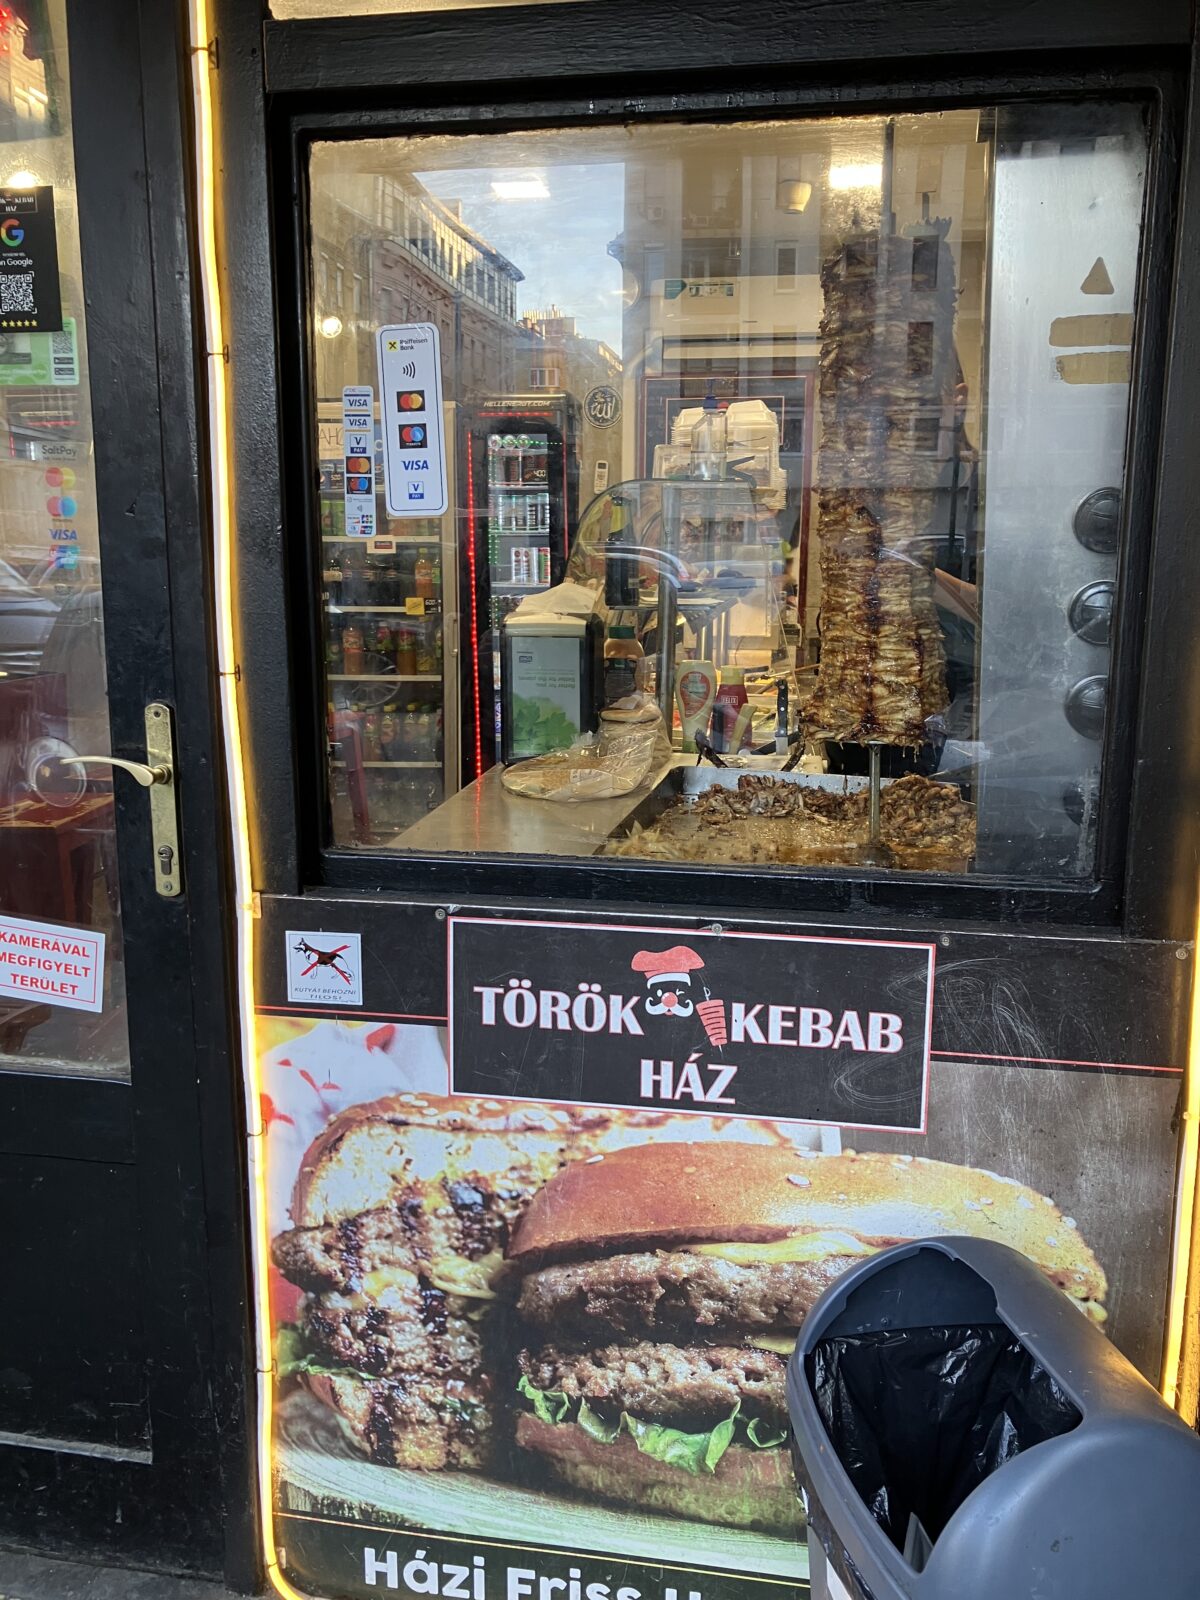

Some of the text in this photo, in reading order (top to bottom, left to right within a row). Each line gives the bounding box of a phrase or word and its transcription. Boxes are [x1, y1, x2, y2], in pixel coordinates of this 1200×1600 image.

[7, 257, 33, 267] Google
[348, 399, 368, 407] VISA
[349, 418, 368, 427] VISA
[354, 436, 362, 446] V
[42, 444, 77, 456] SaltPay
[401, 460, 429, 470] VISA
[412, 483, 420, 491] V
[50, 529, 78, 540] VISA
[0, 931, 90, 958] KAMERÁVAL
[0, 951, 91, 978] MEGFIGYELT
[10, 972, 79, 996] TERÜLET
[473, 978, 904, 1054] TÖRÖK KEBAB
[639, 1053, 738, 1105] HÁZ
[364, 1547, 486, 1600] Házi
